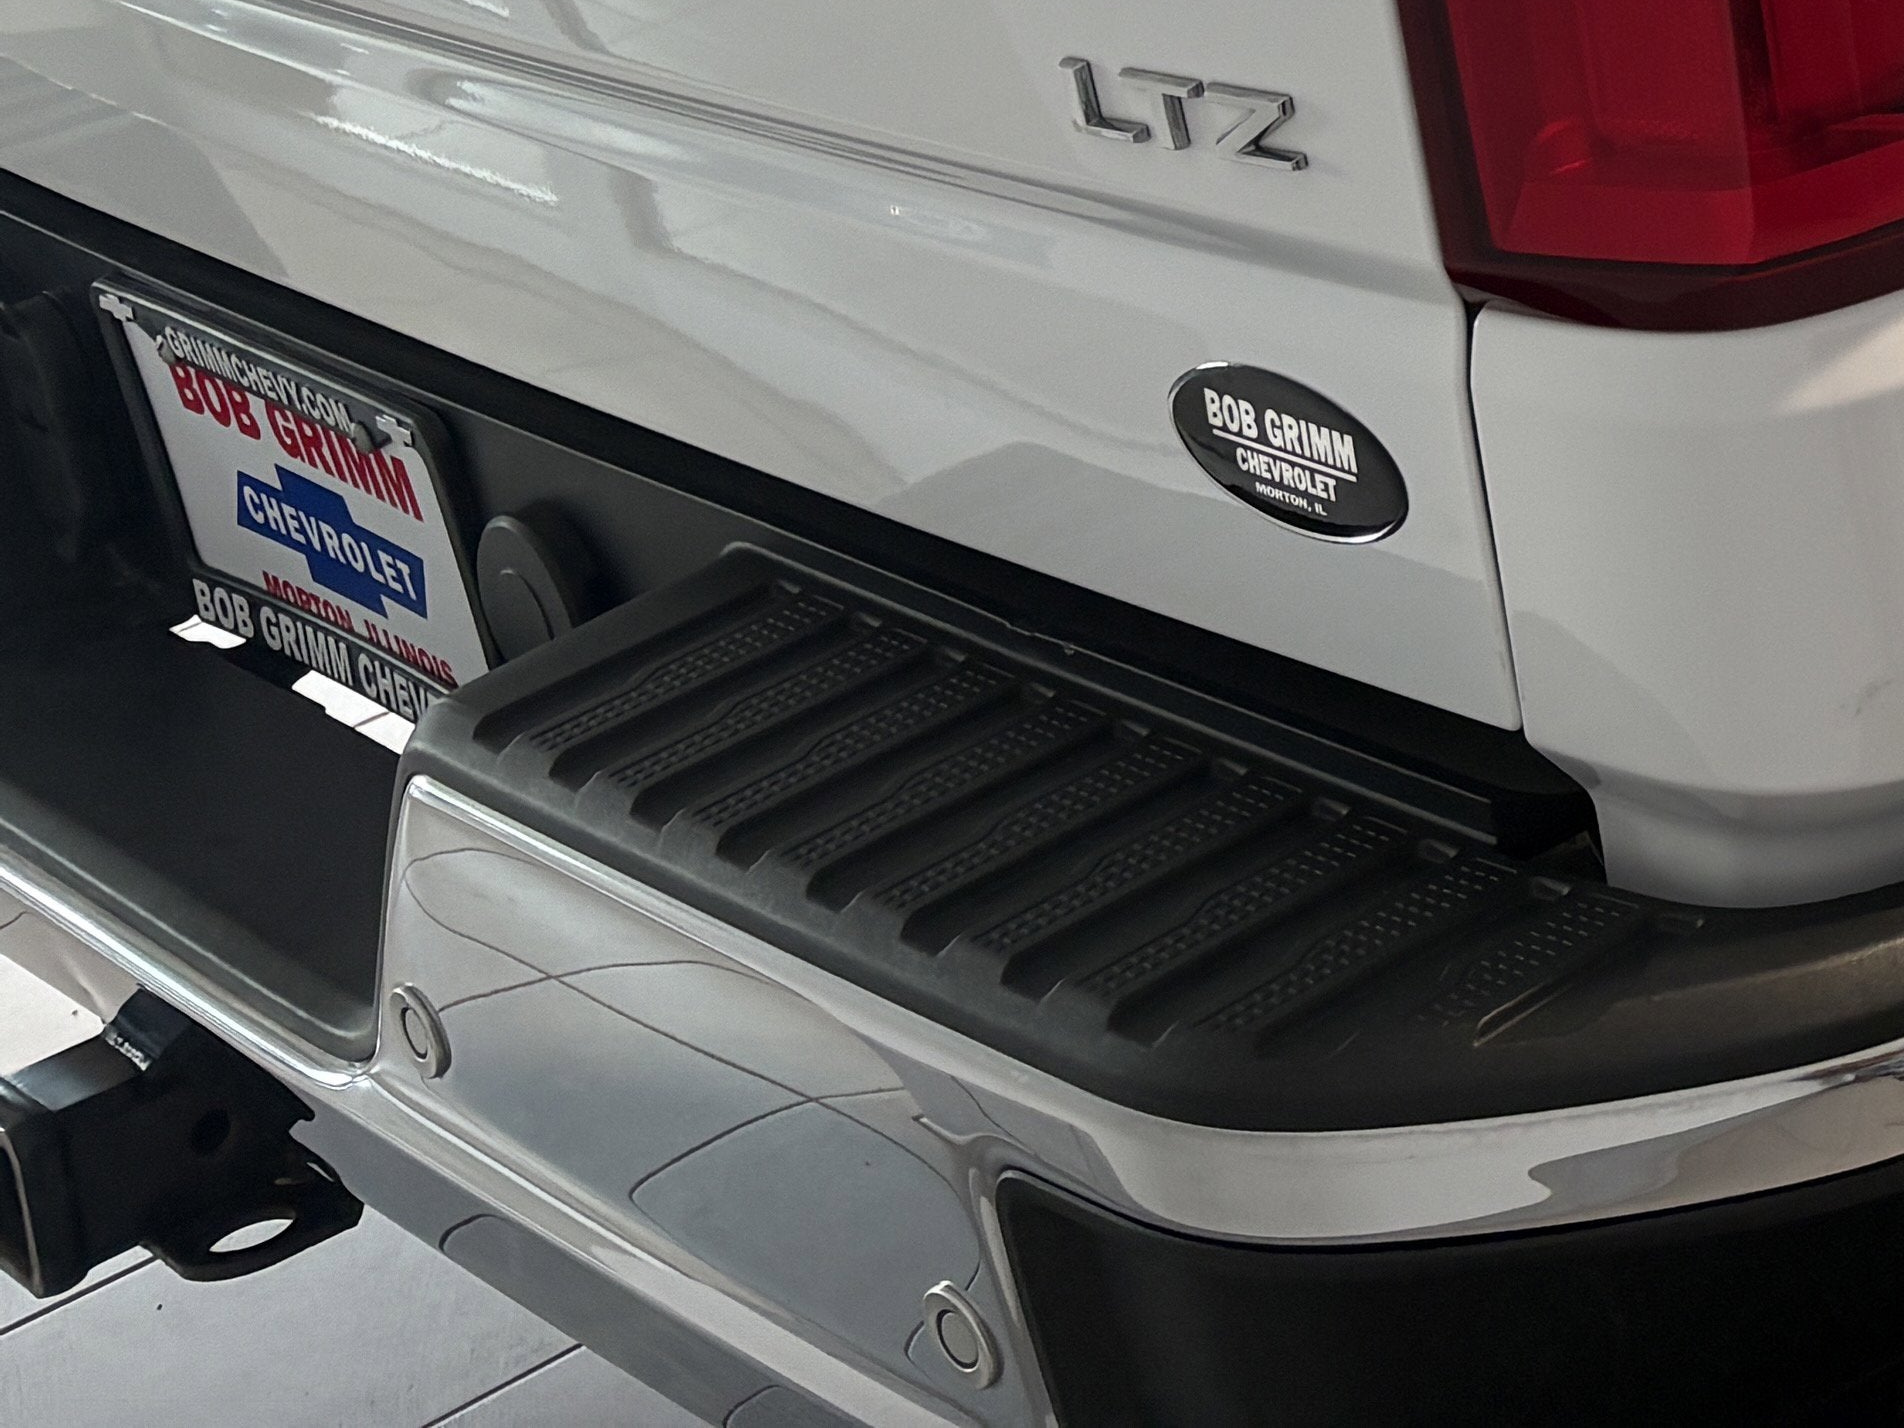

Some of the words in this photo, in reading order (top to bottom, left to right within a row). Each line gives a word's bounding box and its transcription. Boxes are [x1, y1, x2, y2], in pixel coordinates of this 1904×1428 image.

[1058, 55, 1309, 172] LTZ
[164, 326, 352, 433] GRIMMCHEVY.COM
[1204, 387, 1258, 439] BOB
[1264, 408, 1358, 474] GRIMM
[169, 361, 261, 440] BOB
[264, 398, 424, 523] GRIMM
[1236, 447, 1336, 502] CHEVROLET
[242, 485, 417, 601] CHEVROLET
[1255, 482, 1312, 512] MORTON,
[1315, 503, 1328, 516] IL
[192, 578, 255, 639] BOB
[259, 606, 354, 688] GRIMM
[358, 653, 437, 721] CHEV
[363, 619, 459, 689] ILLINOIS
